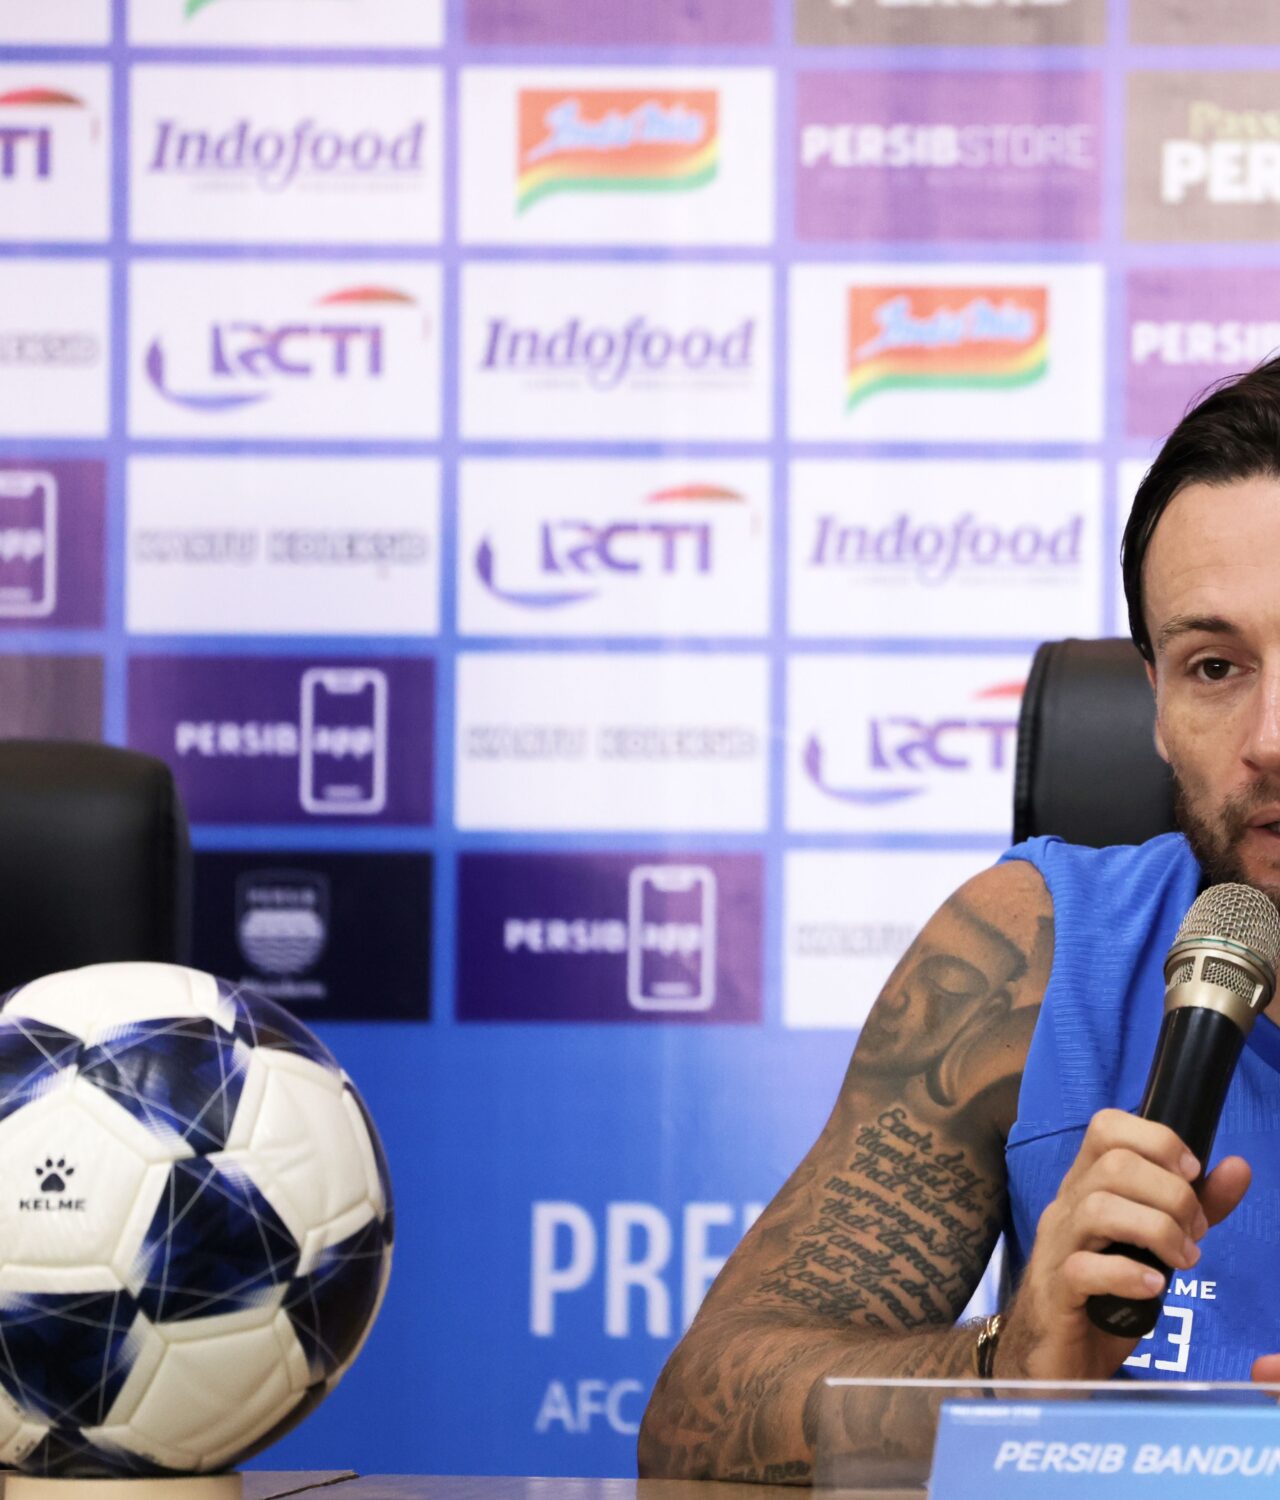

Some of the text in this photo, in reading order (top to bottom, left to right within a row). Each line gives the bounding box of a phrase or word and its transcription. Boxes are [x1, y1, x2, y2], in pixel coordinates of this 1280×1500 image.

[149, 117, 426, 192] Indofood
[209, 322, 383, 378] RCTI
[481, 316, 755, 391] Indofood
[539, 520, 711, 574] RCTI
[809, 513, 1083, 584] Indofood
[19, 1199, 86, 1211] KELME
[534, 1378, 645, 1434] AFC
[995, 1441, 1125, 1473] PERSIB
